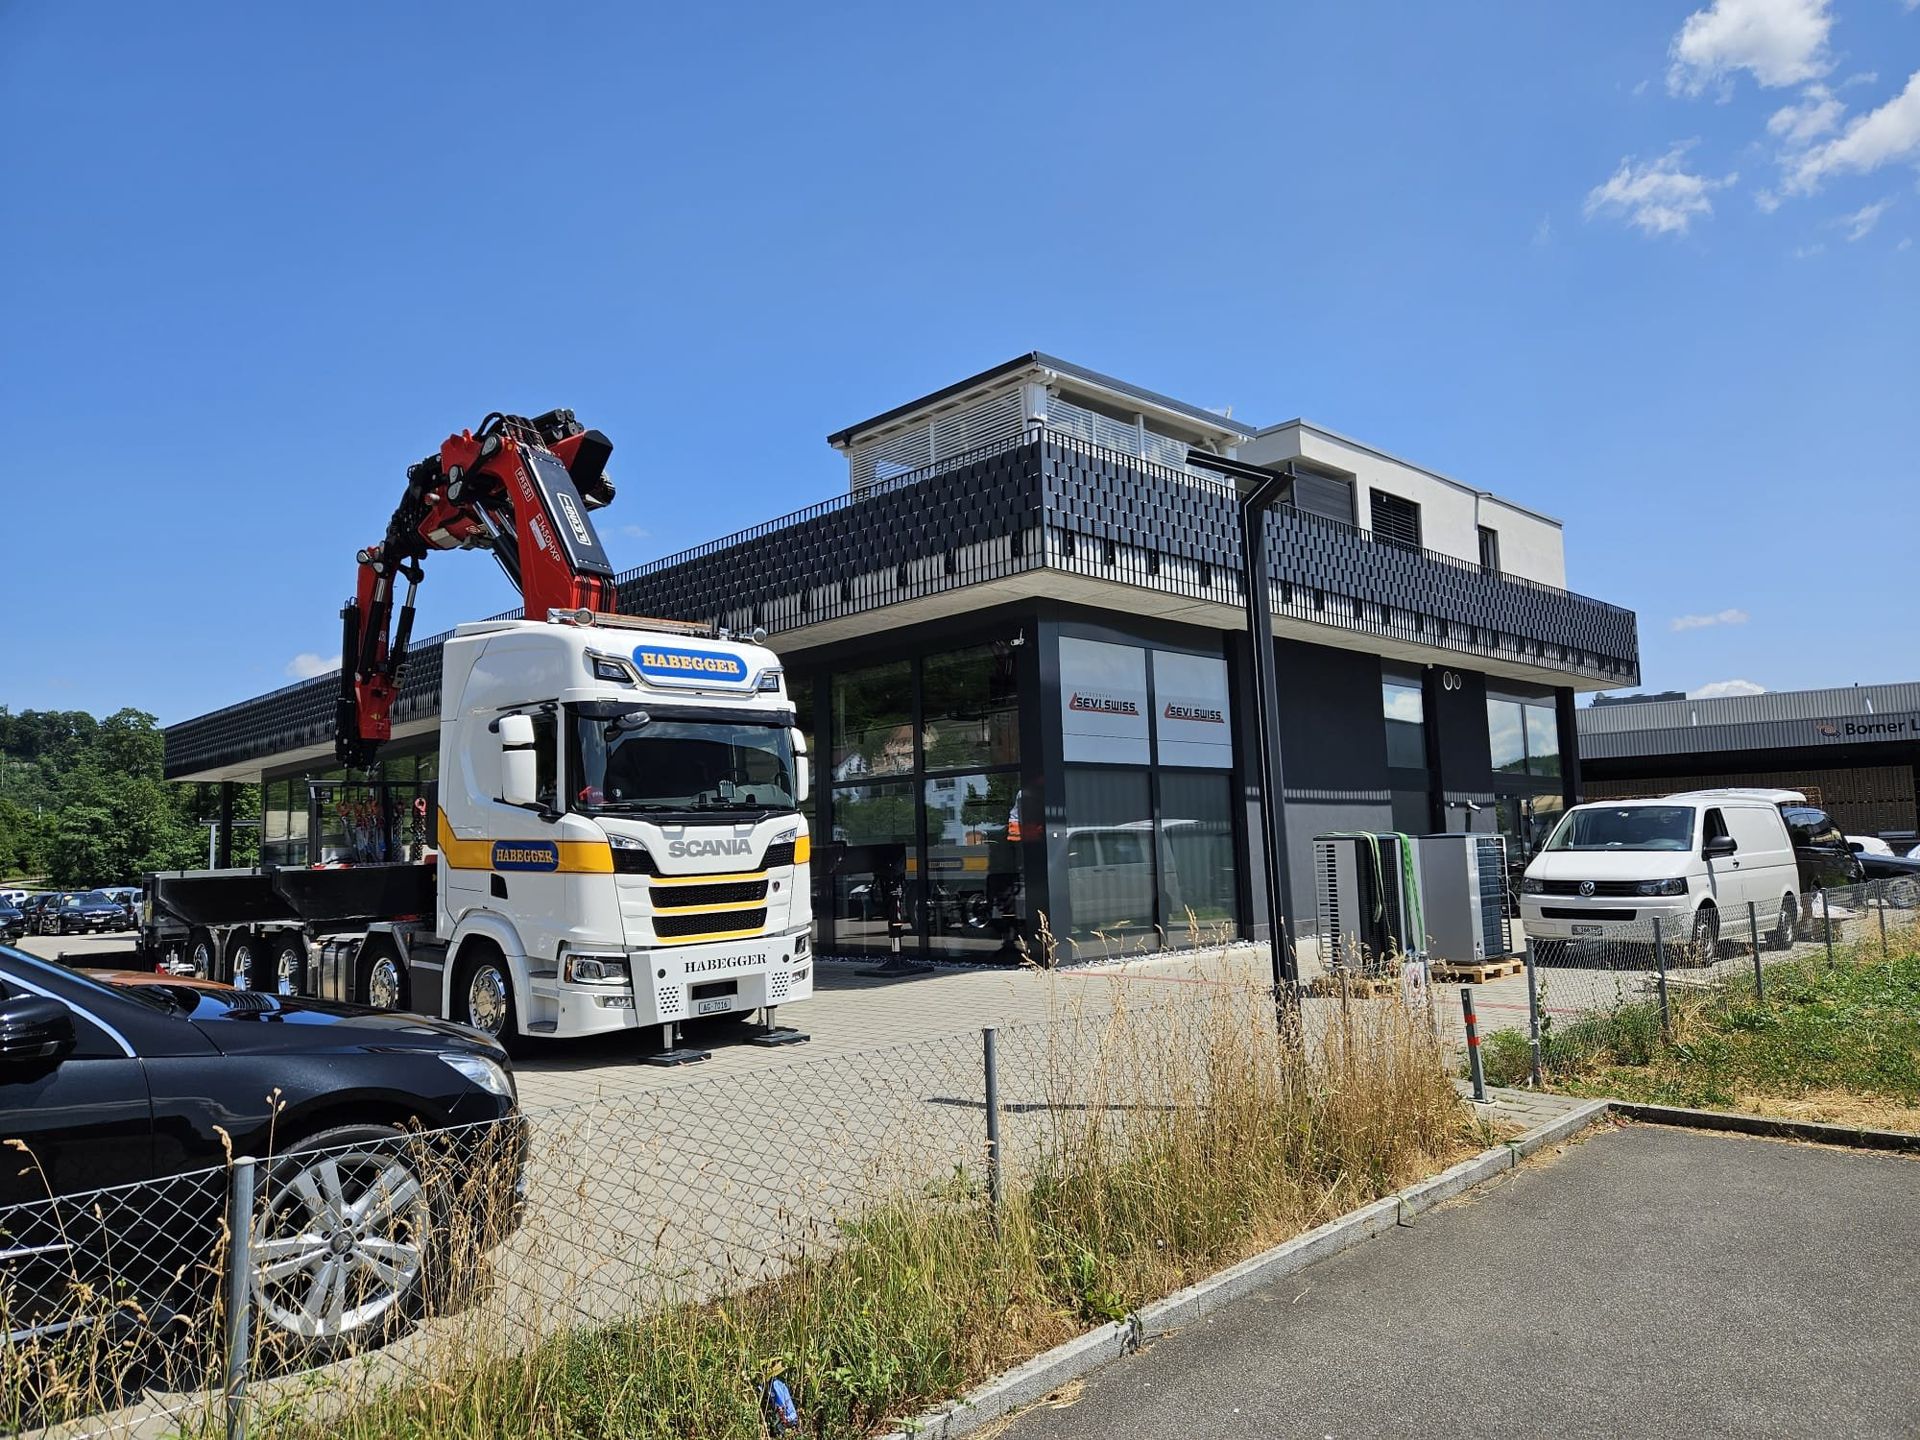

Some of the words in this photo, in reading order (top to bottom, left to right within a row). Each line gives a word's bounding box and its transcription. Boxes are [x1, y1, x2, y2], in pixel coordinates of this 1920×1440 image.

[641, 653, 739, 674] HABEGGER
[1104, 700, 1136, 712] SWISS
[1194, 709, 1221, 720] SWISS
[1845, 722, 1905, 735] Borner
[668, 839, 753, 858] SCANIA
[496, 849, 554, 863] HABEGGER
[684, 953, 767, 973] HABEGGER
